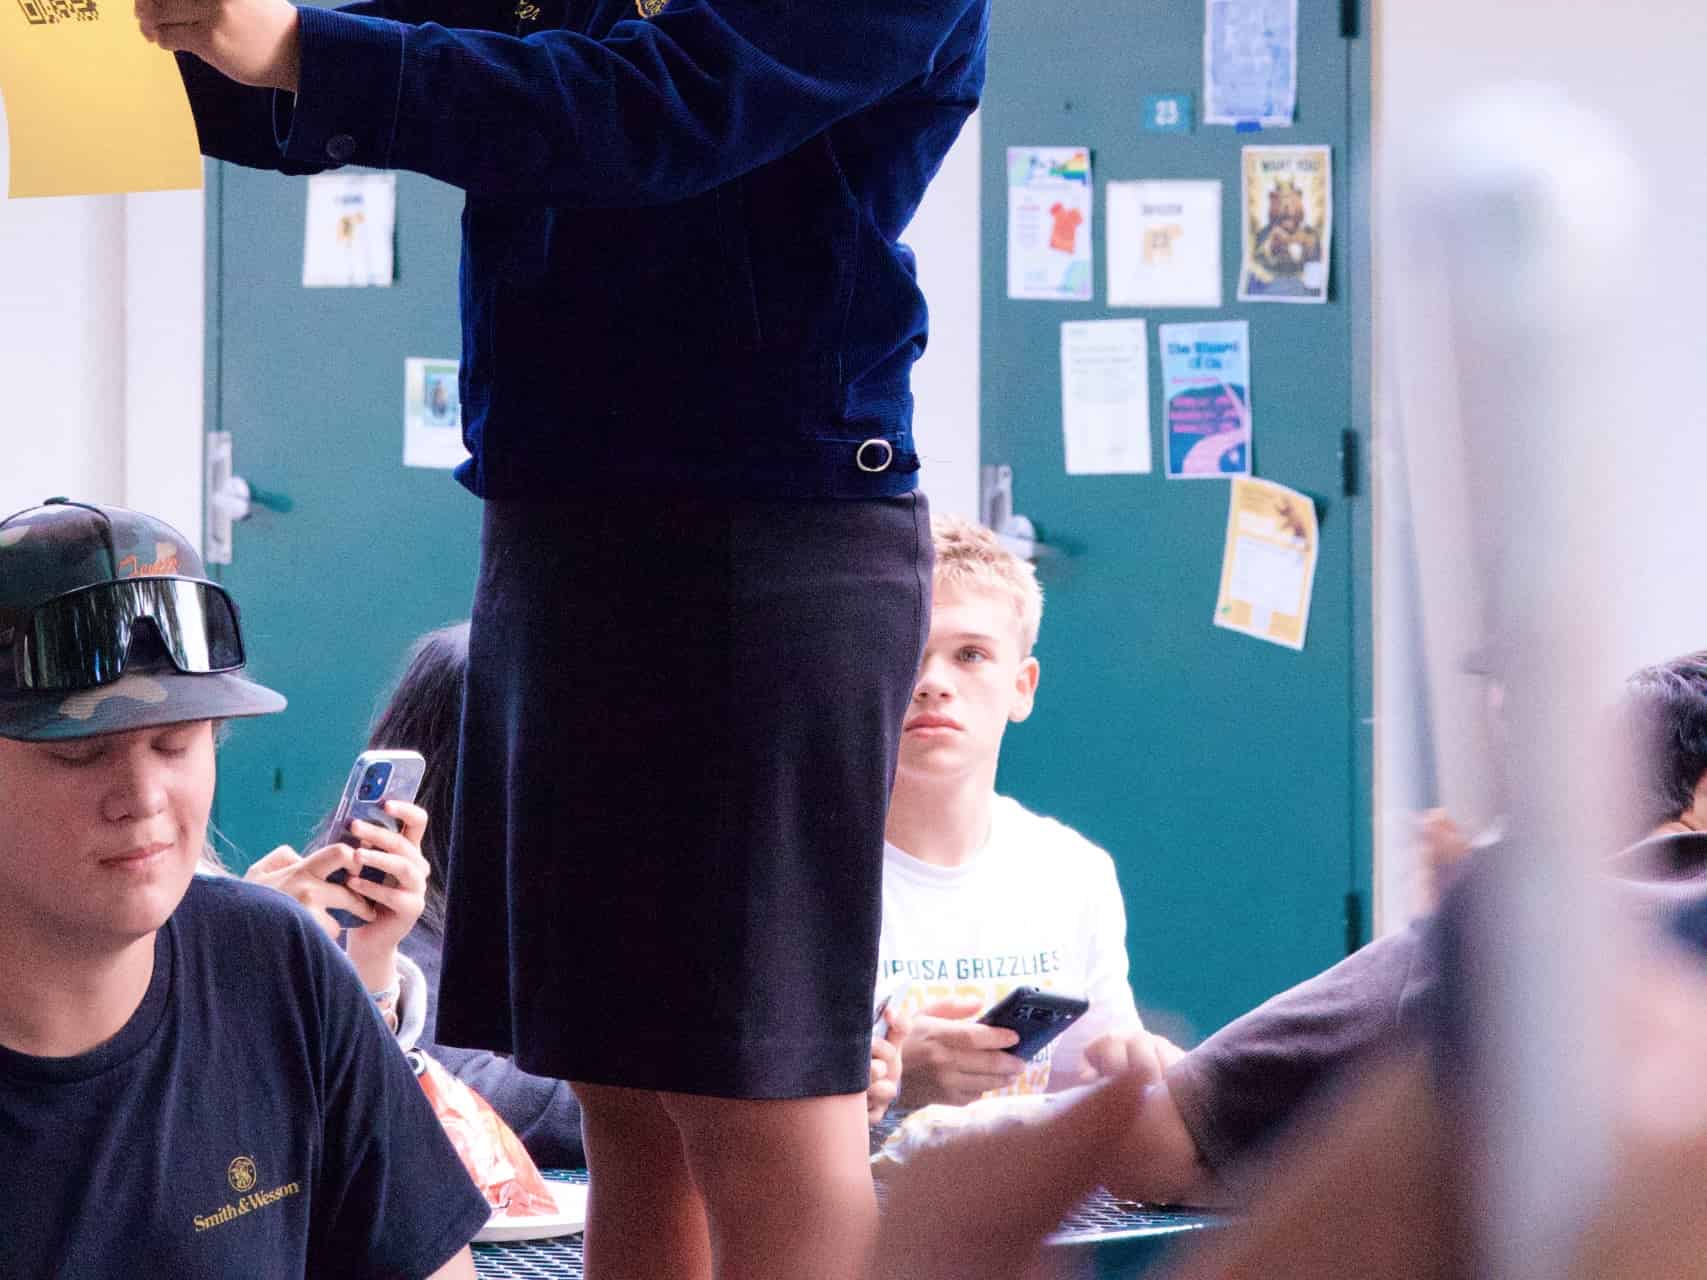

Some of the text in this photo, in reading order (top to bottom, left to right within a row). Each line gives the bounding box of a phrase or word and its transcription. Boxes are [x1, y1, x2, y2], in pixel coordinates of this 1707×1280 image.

[883, 950, 1060, 981] IPOSA GRIZZLIES
[193, 1181, 299, 1232] Smith & Wesson
